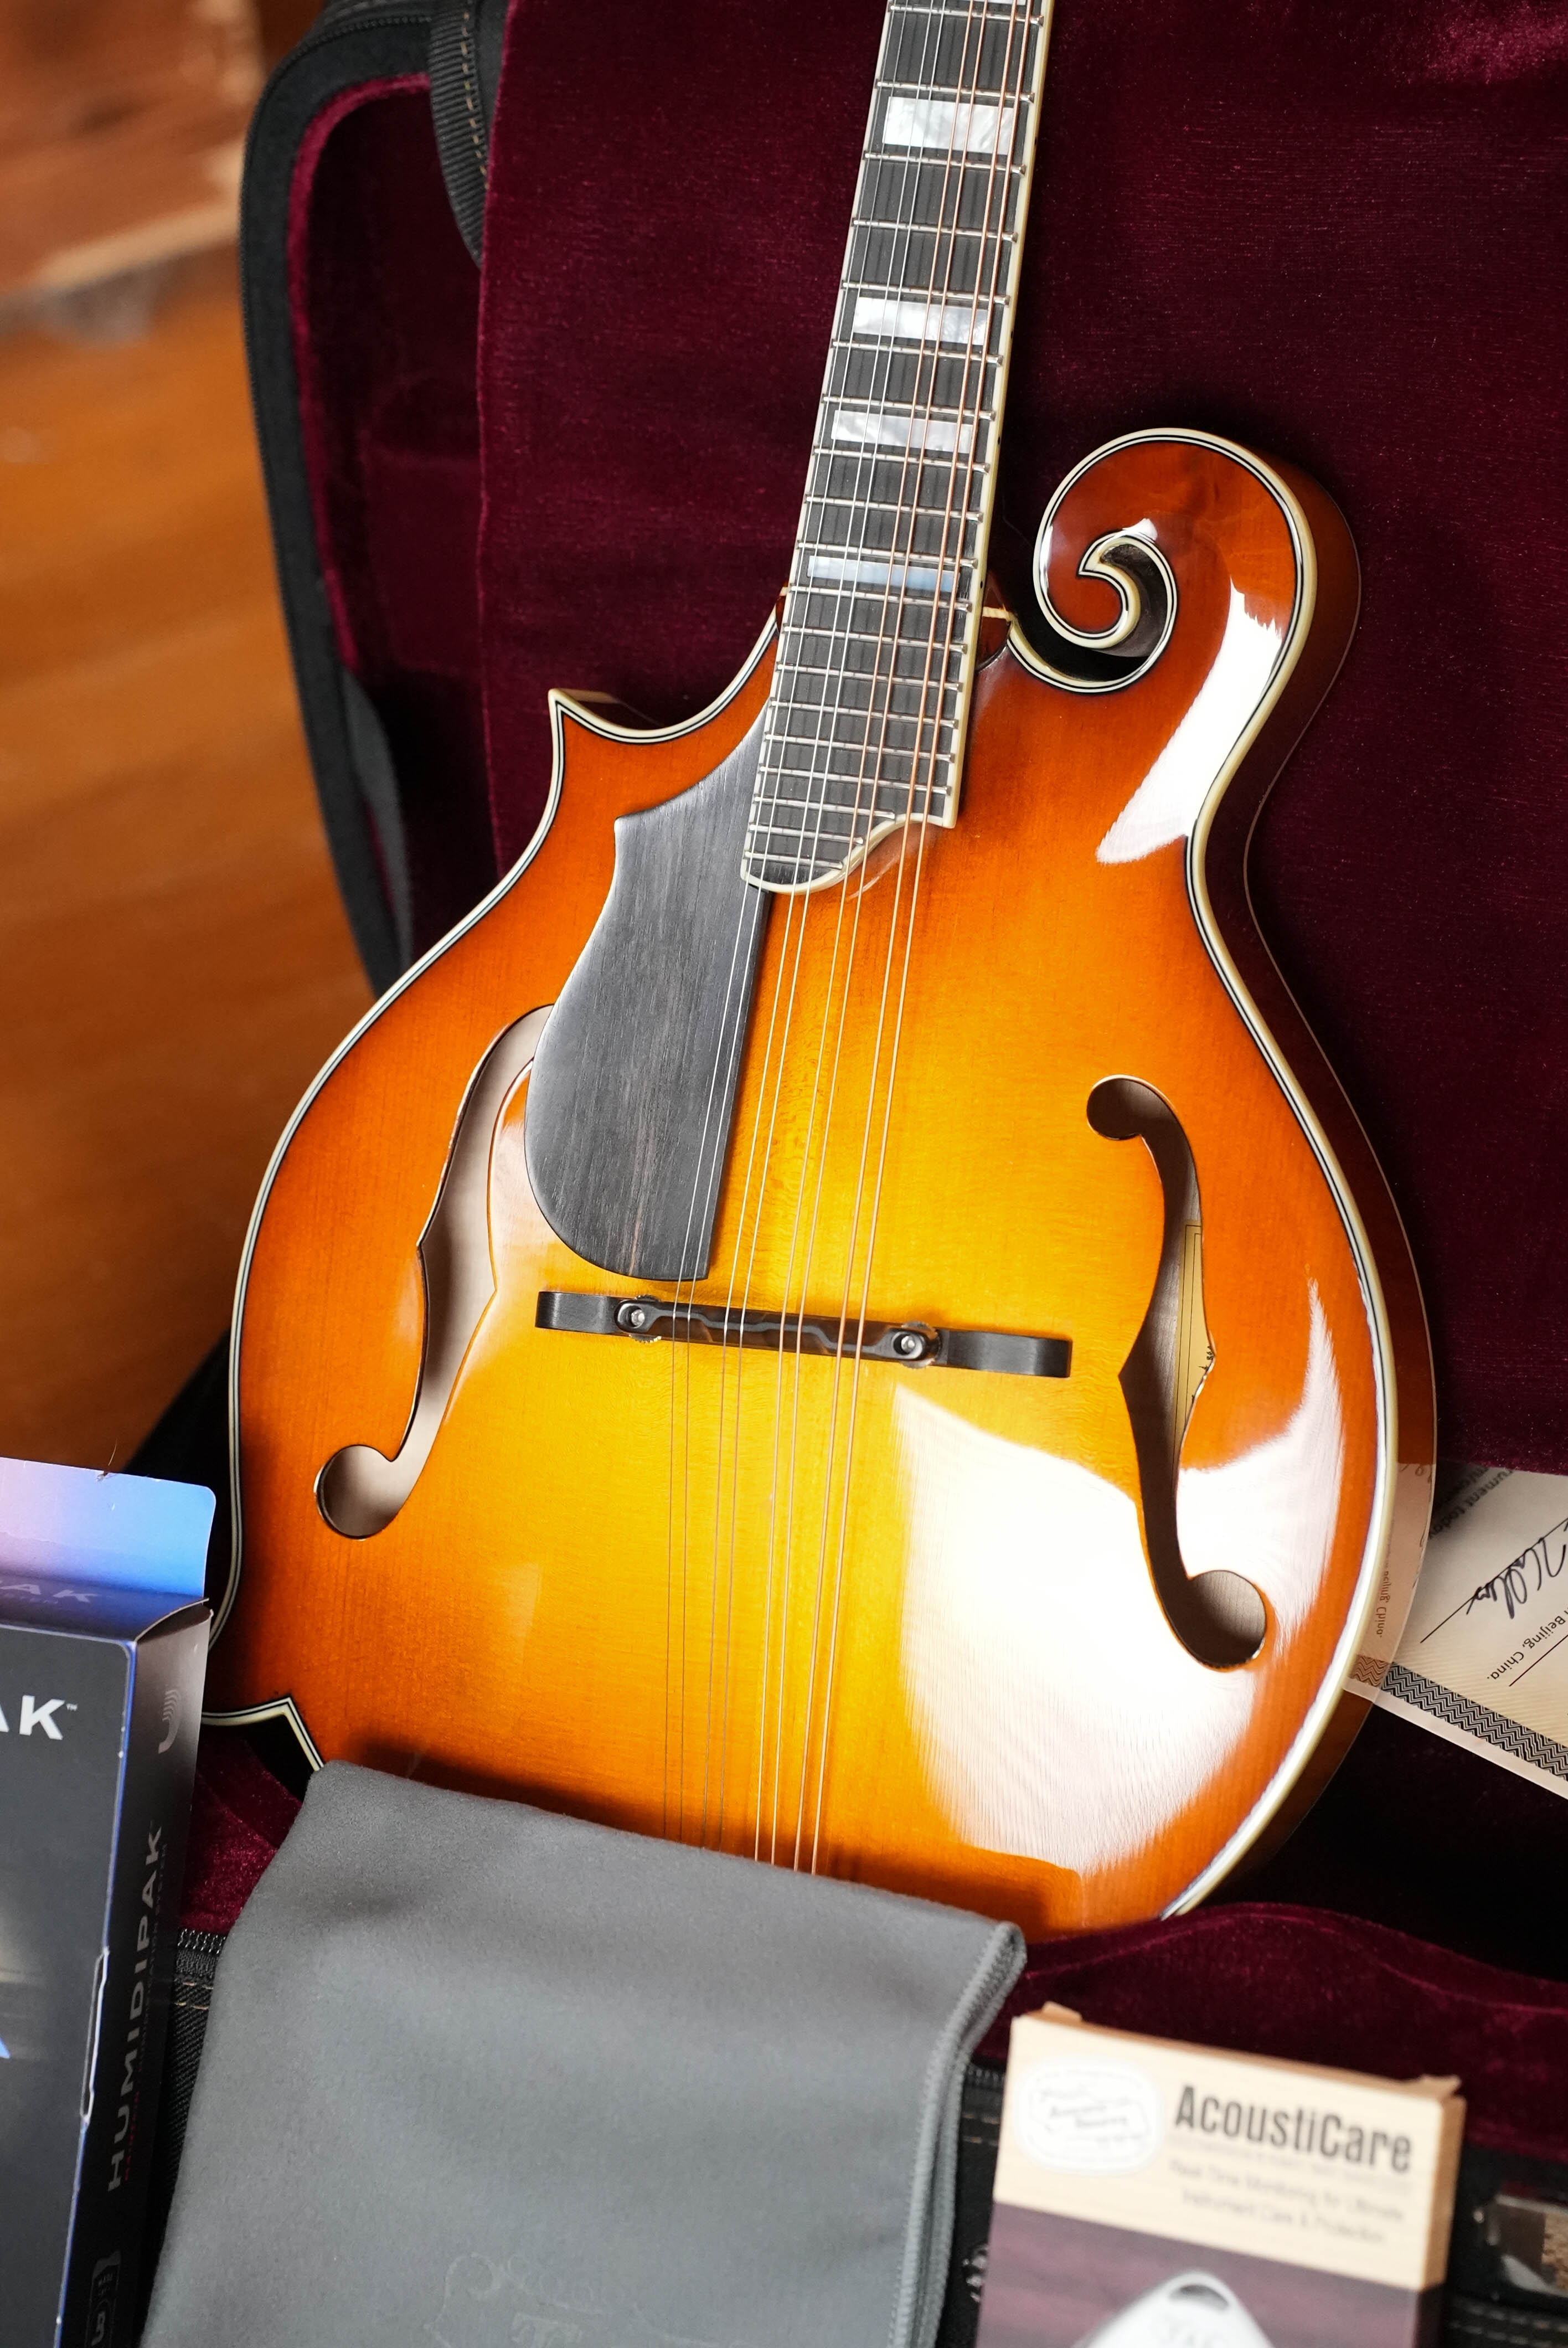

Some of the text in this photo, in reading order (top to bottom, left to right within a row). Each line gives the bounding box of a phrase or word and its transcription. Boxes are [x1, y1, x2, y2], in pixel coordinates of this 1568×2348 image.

[1487, 1615, 1566, 1680] Beijing, China.
[108, 1826, 162, 2192] HUMIDIPAK
[1175, 2086, 1412, 2172] AcoustiCare
